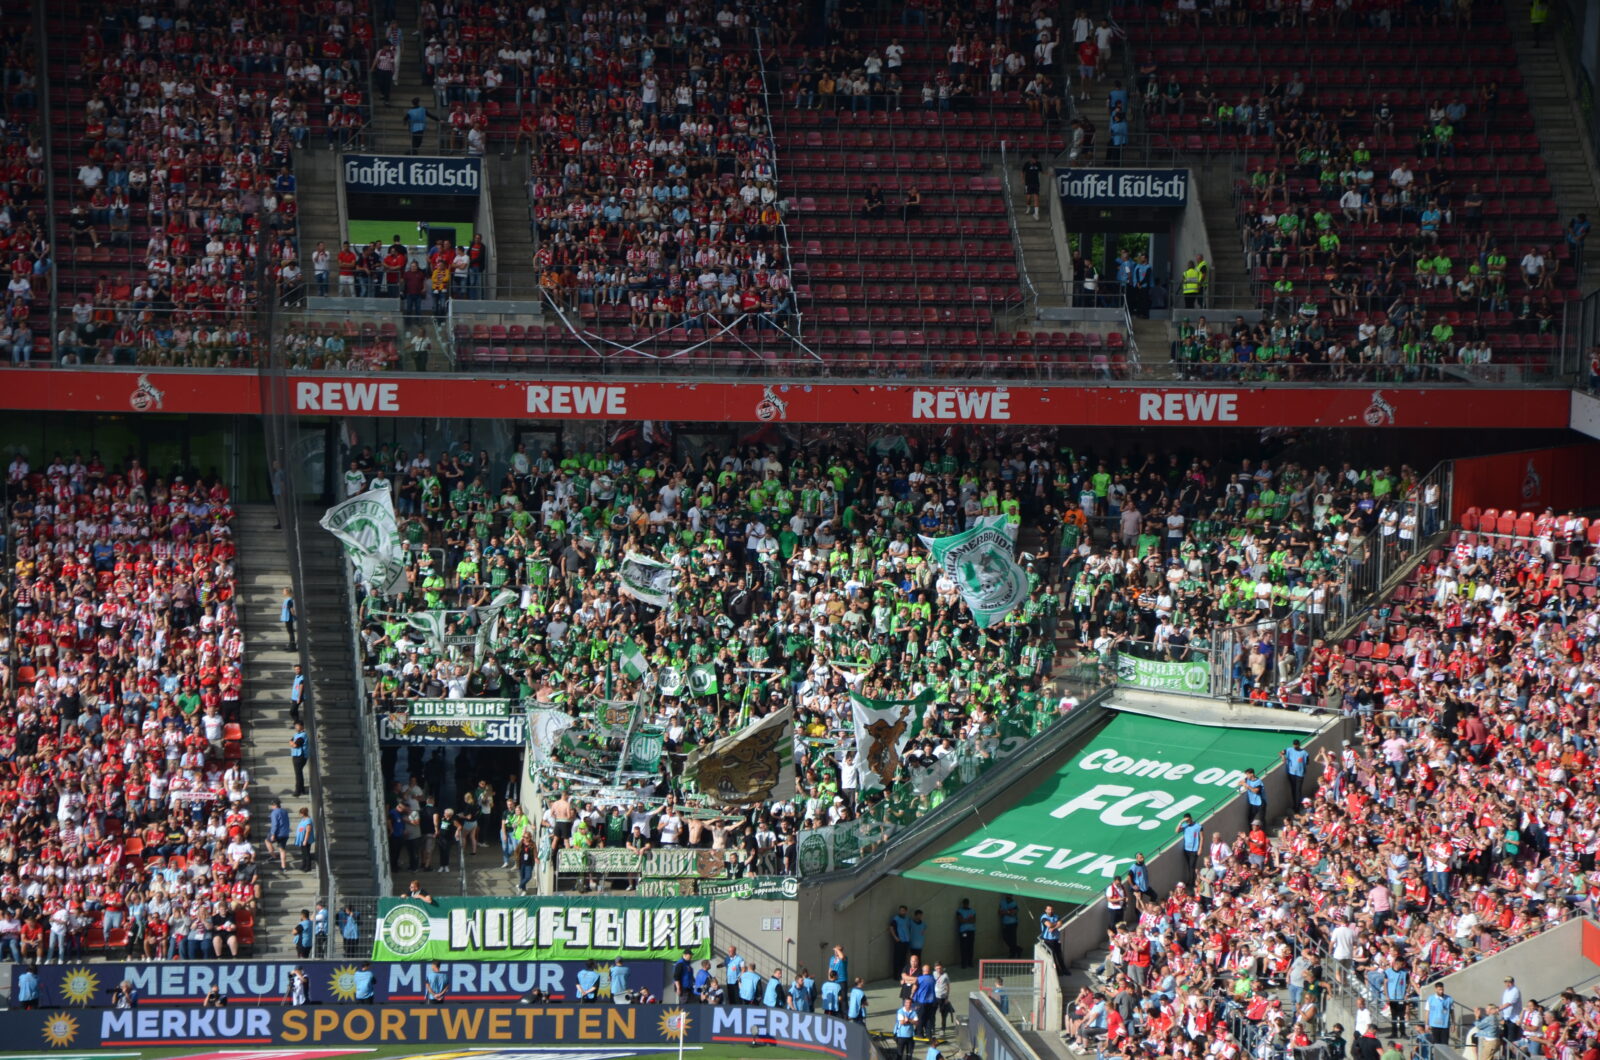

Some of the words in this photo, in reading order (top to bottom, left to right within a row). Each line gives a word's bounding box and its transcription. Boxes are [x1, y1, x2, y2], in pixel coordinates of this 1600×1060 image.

[345, 158, 406, 187] Gaffel
[410, 162, 478, 190] Kölsch
[1057, 172, 1115, 199] Gaffel
[1119, 174, 1185, 201] Kölsch
[296, 382, 399, 412] REWE
[526, 385, 627, 415] REWE
[912, 390, 1010, 420] REWE
[1139, 393, 1238, 421] REWE
[1078, 748, 1195, 781] Come
[1050, 783, 1206, 830] FC!
[703, 883, 750, 895] SALZGITTER
[939, 862, 985, 875] Gesagt.
[989, 870, 1029, 881] Getan.
[1033, 876, 1093, 891] Geholfen.
[449, 907, 706, 950] WOLFSBURG
[122, 965, 295, 995] MERKU
[388, 964, 564, 994] MRKUR
[100, 1007, 272, 1039] MERKUR
[280, 1007, 636, 1042] SPORTWETTEN
[712, 1006, 848, 1050] MERKUR
